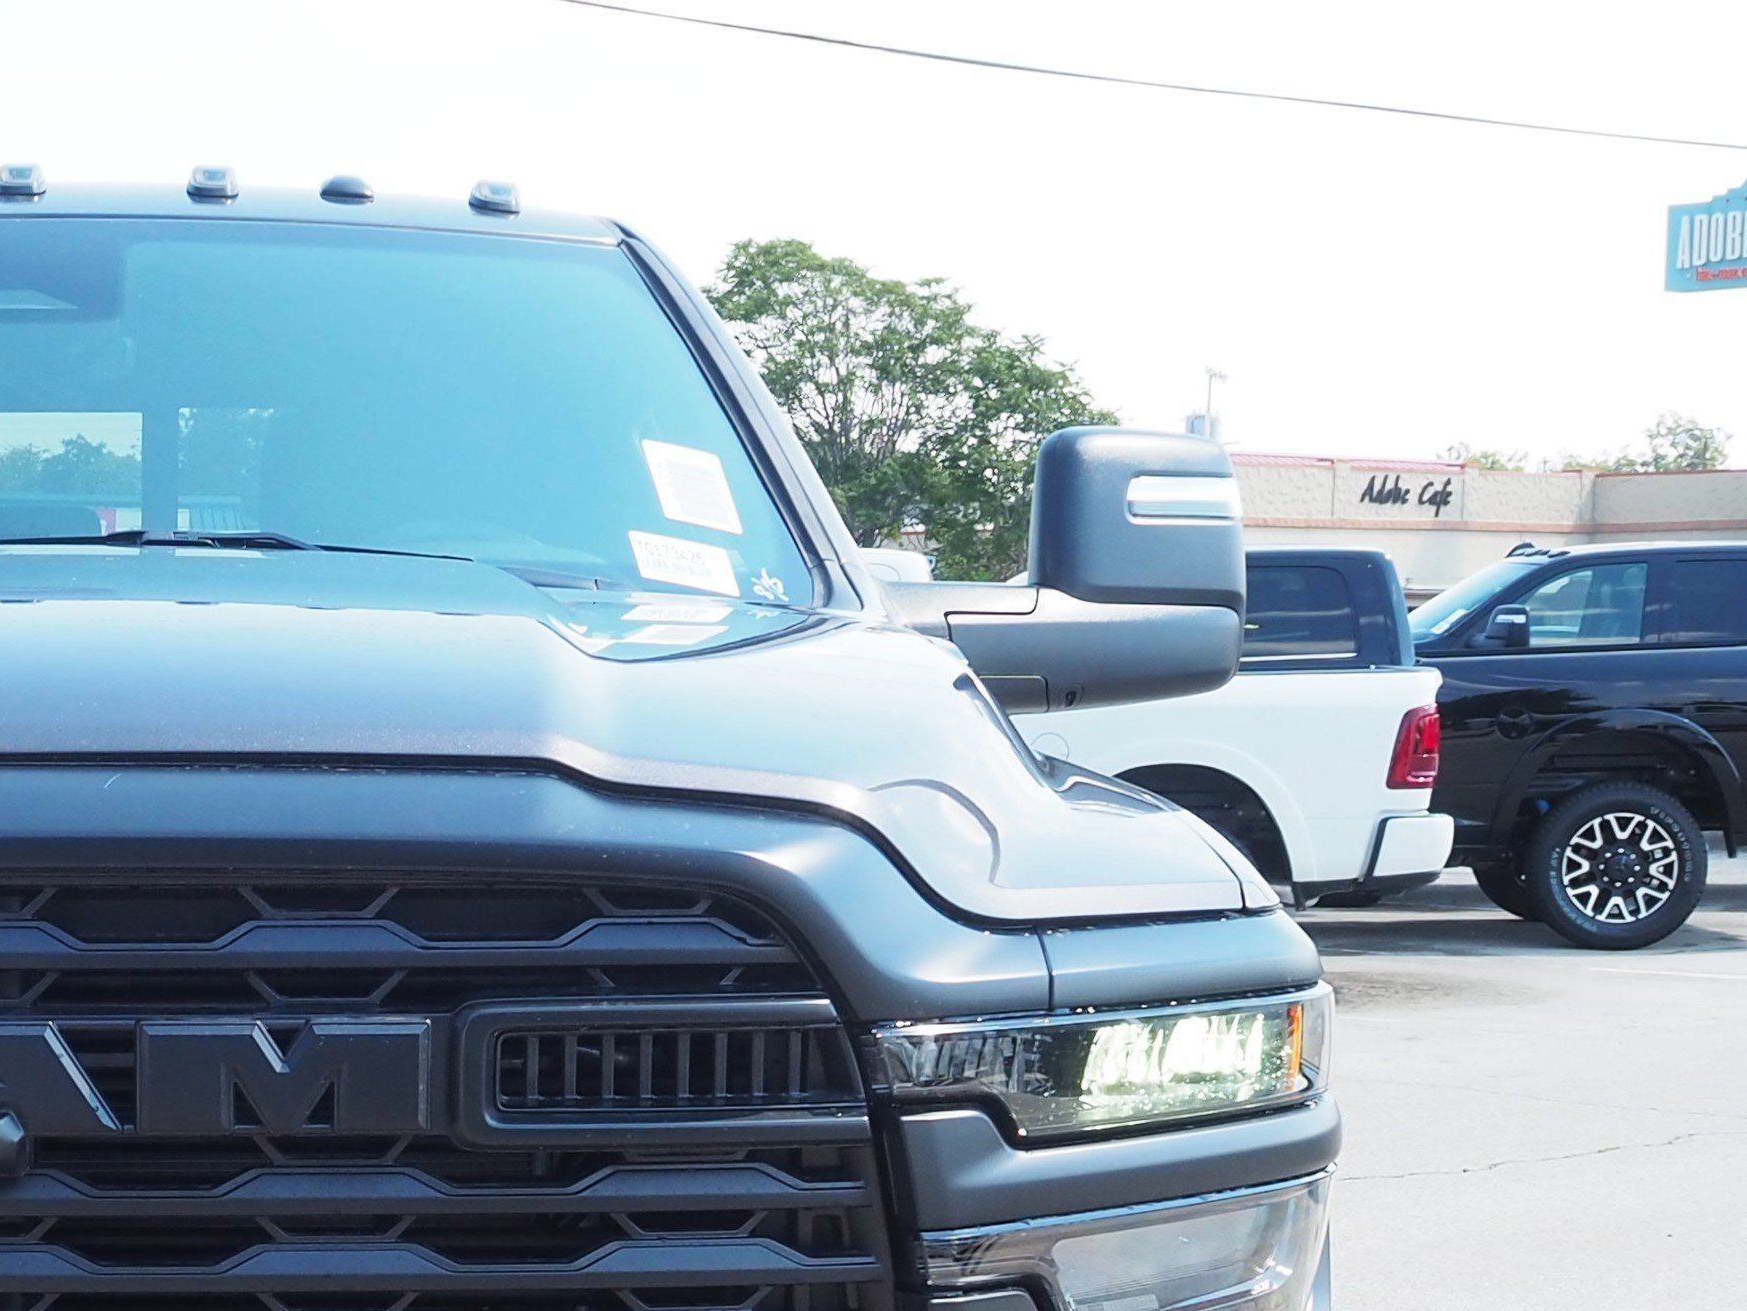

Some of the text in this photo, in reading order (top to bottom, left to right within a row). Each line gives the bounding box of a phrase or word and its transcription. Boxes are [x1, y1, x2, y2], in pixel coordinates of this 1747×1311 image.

[1676, 210, 1747, 269] ADOB
[1359, 474, 1454, 518] Adobe Cafe
